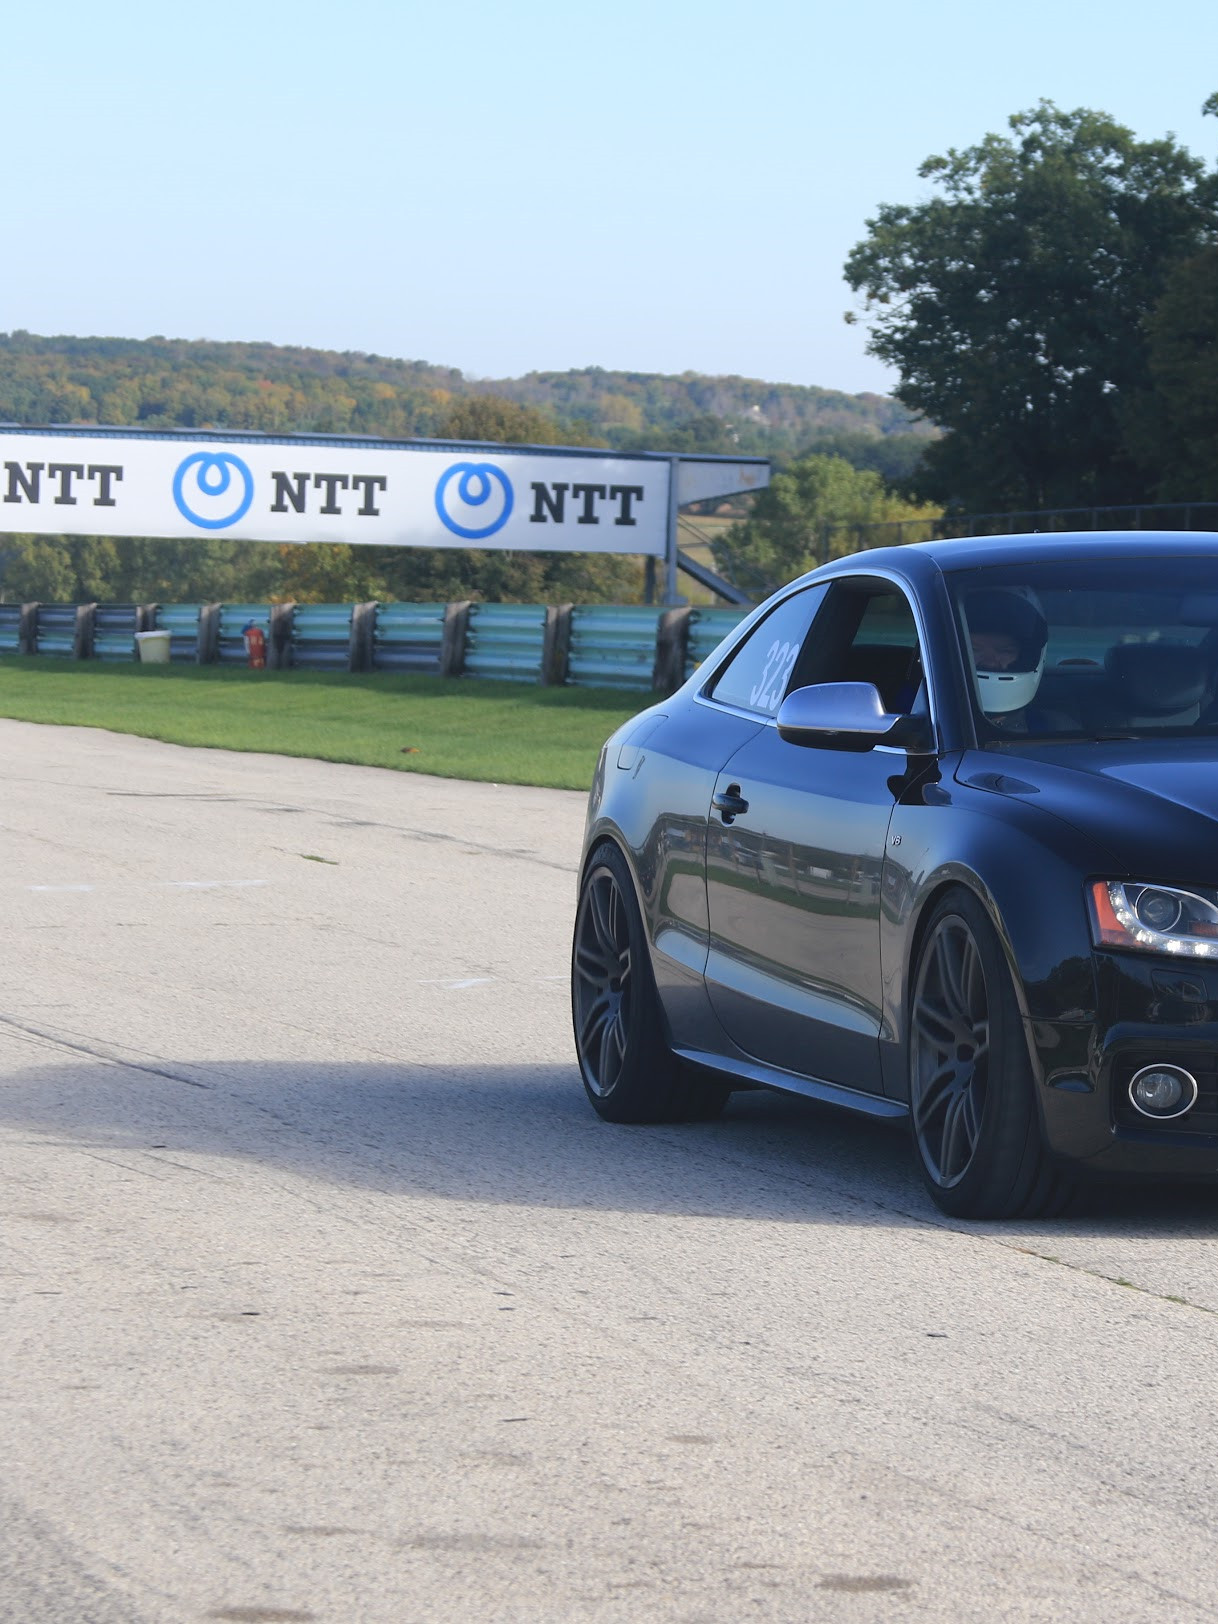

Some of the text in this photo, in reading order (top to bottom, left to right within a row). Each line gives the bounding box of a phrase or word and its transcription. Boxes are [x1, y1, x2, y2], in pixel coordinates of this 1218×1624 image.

[3, 461, 124, 507] NTT
[270, 471, 388, 517] NTT
[529, 481, 645, 527] NTT
[750, 640, 799, 711] 323
